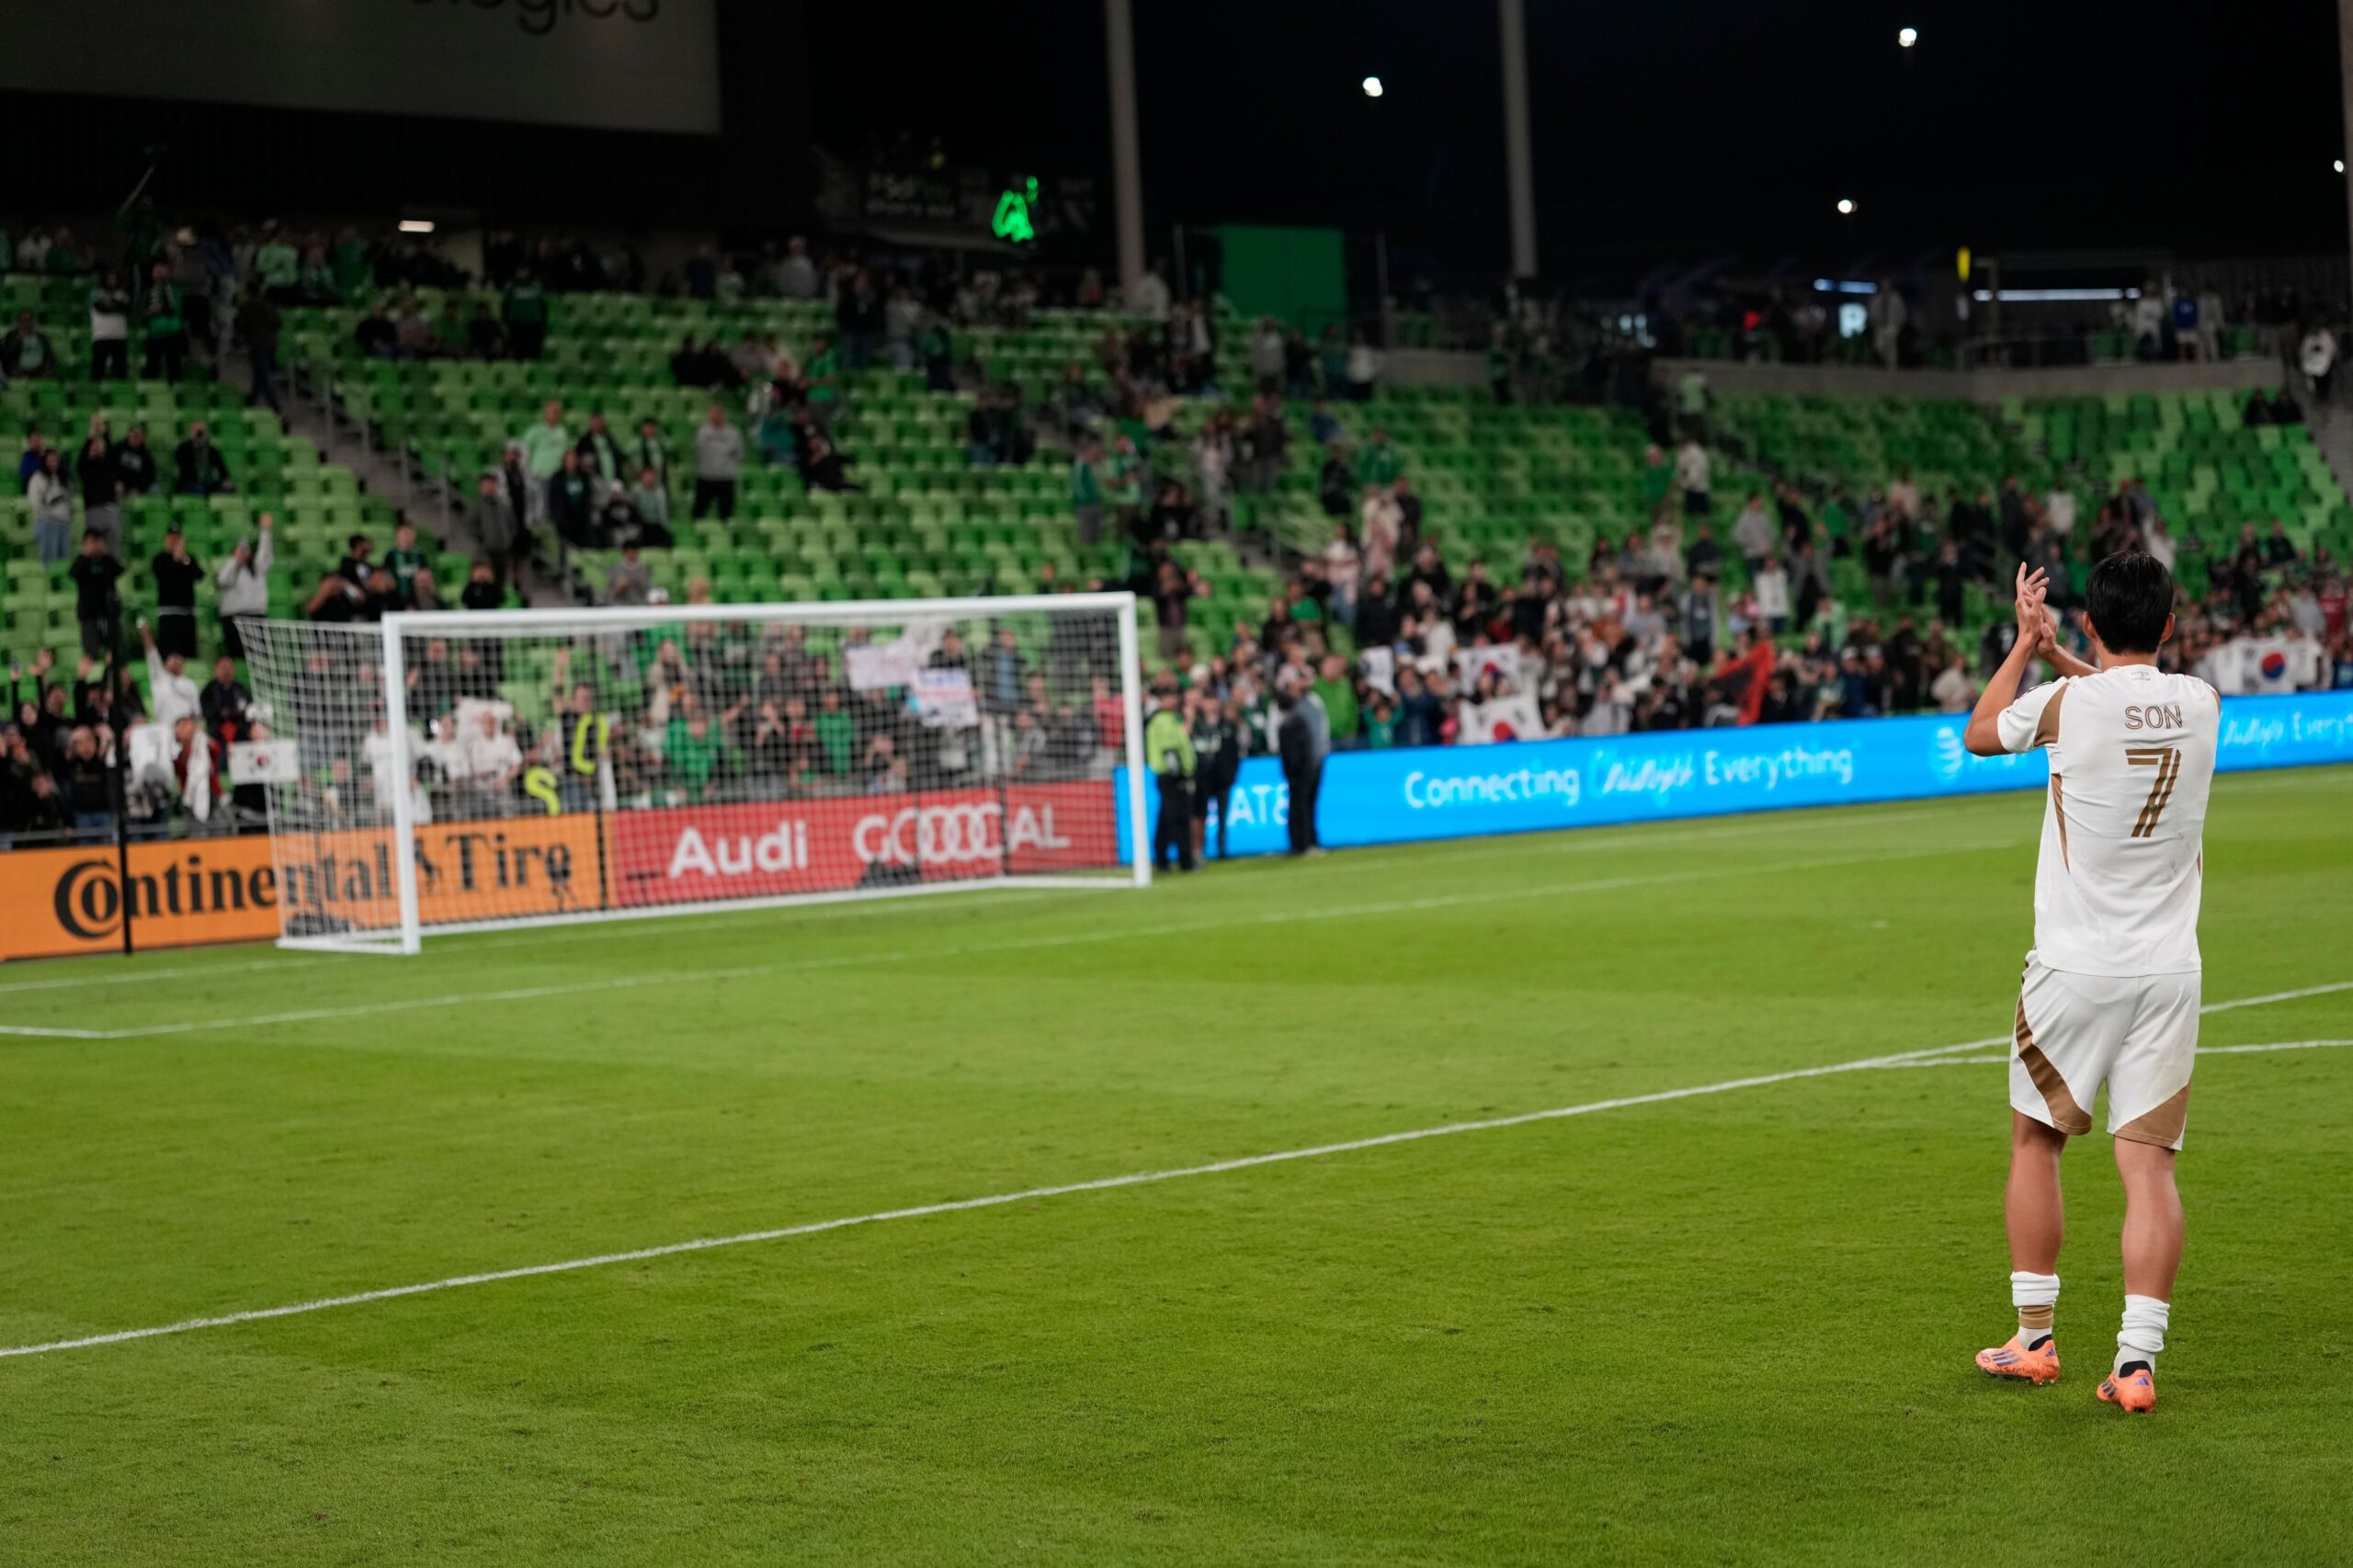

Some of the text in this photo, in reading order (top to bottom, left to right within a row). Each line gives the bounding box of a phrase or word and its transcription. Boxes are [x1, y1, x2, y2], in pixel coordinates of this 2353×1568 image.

[2125, 705, 2183, 730] SON
[1404, 765, 1580, 809] Connecting
[1705, 745, 1852, 790] Everything
[2125, 748, 2181, 837] 7
[669, 818, 808, 879] Audi
[54, 832, 573, 939] Continental Tire
